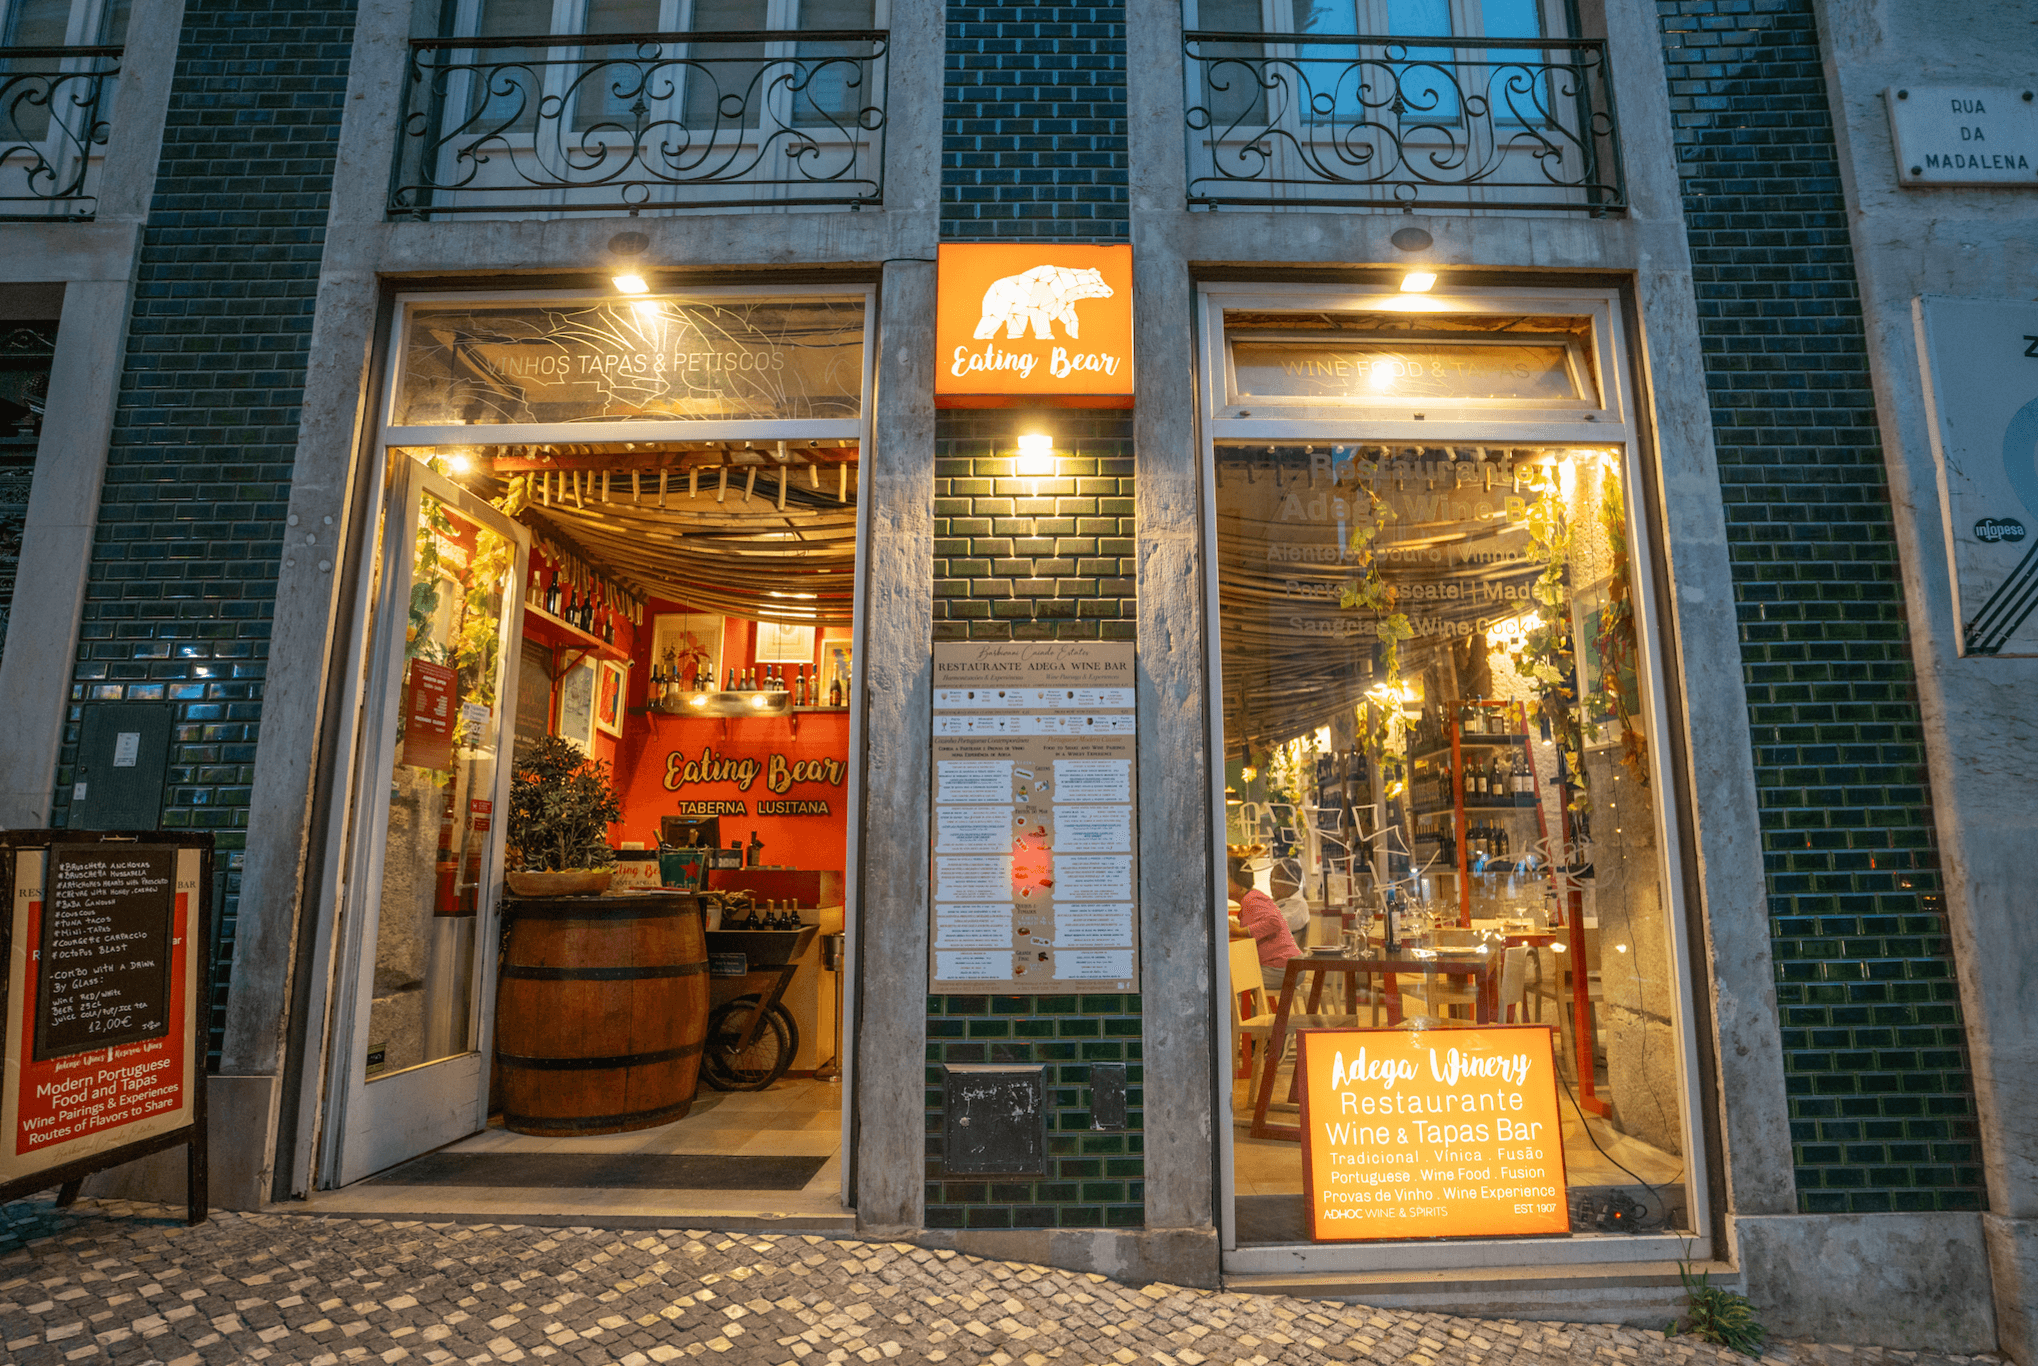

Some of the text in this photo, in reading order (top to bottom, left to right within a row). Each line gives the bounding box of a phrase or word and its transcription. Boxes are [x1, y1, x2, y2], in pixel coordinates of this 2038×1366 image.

[1951, 99, 1986, 114] RUA
[1960, 126, 1985, 141] DA
[1925, 154, 2030, 169] MADALENA
[486, 351, 785, 376] VINHOS TAPAS & PETISCOS
[951, 343, 1120, 379] Eating Bear
[1281, 360, 1350, 377] WINE
[1310, 453, 1535, 483] Restaurante
[1281, 492, 1568, 527] Adega Wine Bar
[1976, 519, 2025, 541] infopesa
[1267, 543, 1356, 565] Alentejo
[1457, 543, 1518, 563] Vinho
[1415, 616, 1470, 636] Wine
[938, 662, 1128, 671] RESTAURANTE ADEGA WINE BAR
[663, 746, 847, 794] Eating Bear
[679, 801, 830, 815] TABERNA LUSITANA
[176, 880, 196, 890] BAR
[89, 1016, 133, 1033] 12,00€
[37, 1058, 171, 1098] Modern Portuguese
[1332, 1046, 1532, 1091] Adega Winery
[52, 1074, 158, 1109] Food and Tapas
[1341, 1088, 1524, 1115] Restaurante
[23, 1083, 179, 1131] Wine Pairings & Experiences
[29, 1096, 174, 1145] Routes of Flavors to Share
[1325, 1118, 1543, 1148] Wine & Tapas Bar
[1330, 1146, 1544, 1165] Tradicional Vínica Fusão
[1331, 1165, 1545, 1186] Portuguese Wine Food Fusion
[1323, 1184, 1556, 1203] Provas de Vinho Wine Experience
[1323, 1208, 1363, 1220] ADHOC
[1365, 1207, 1396, 1218] WINE
[1399, 1207, 1407, 1218] &
[1409, 1206, 1448, 1217] SPIRITS
[1536, 1202, 1557, 1213] 1907
